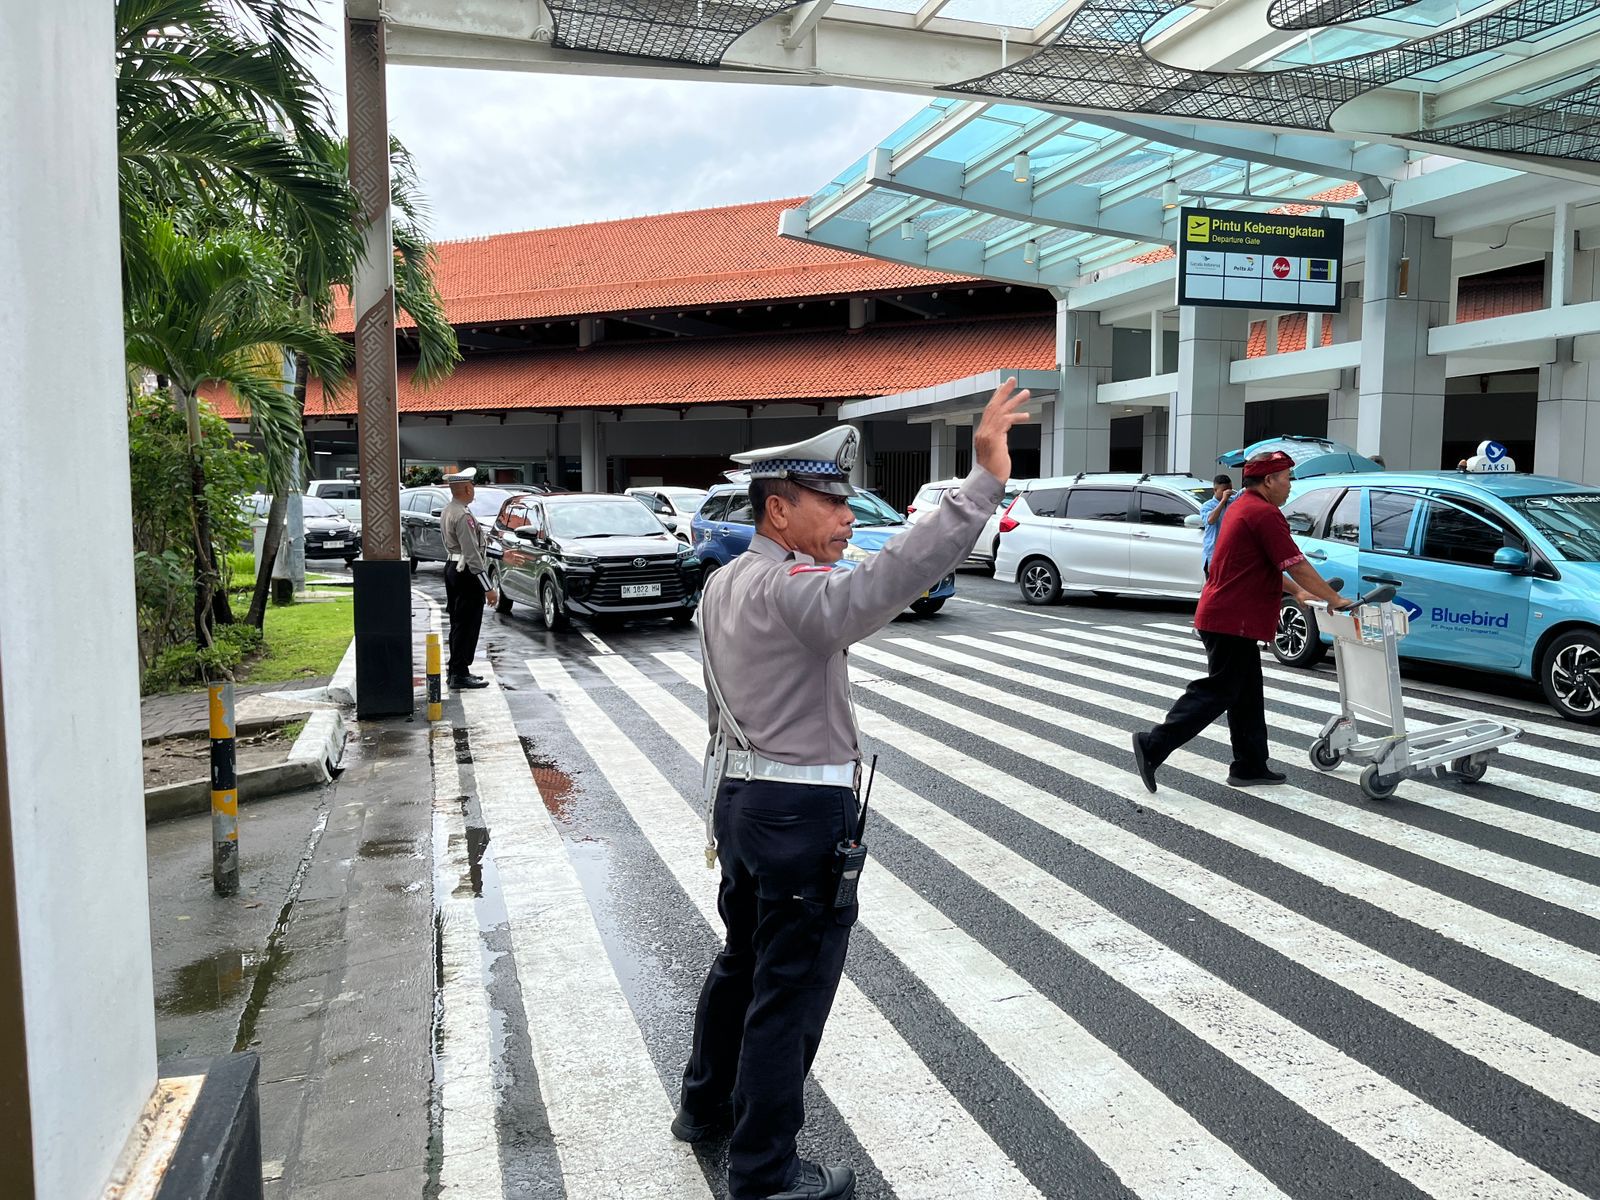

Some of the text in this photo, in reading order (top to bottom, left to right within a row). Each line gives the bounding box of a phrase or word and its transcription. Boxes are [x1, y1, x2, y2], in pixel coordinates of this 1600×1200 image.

[1212, 219, 1325, 238] Pintu Keberangkatan
[1212, 234, 1260, 245] Departure Gate
[1482, 463, 1509, 471] TAKSI
[623, 586, 631, 594] DK
[1431, 607, 1509, 628] Bluebird
